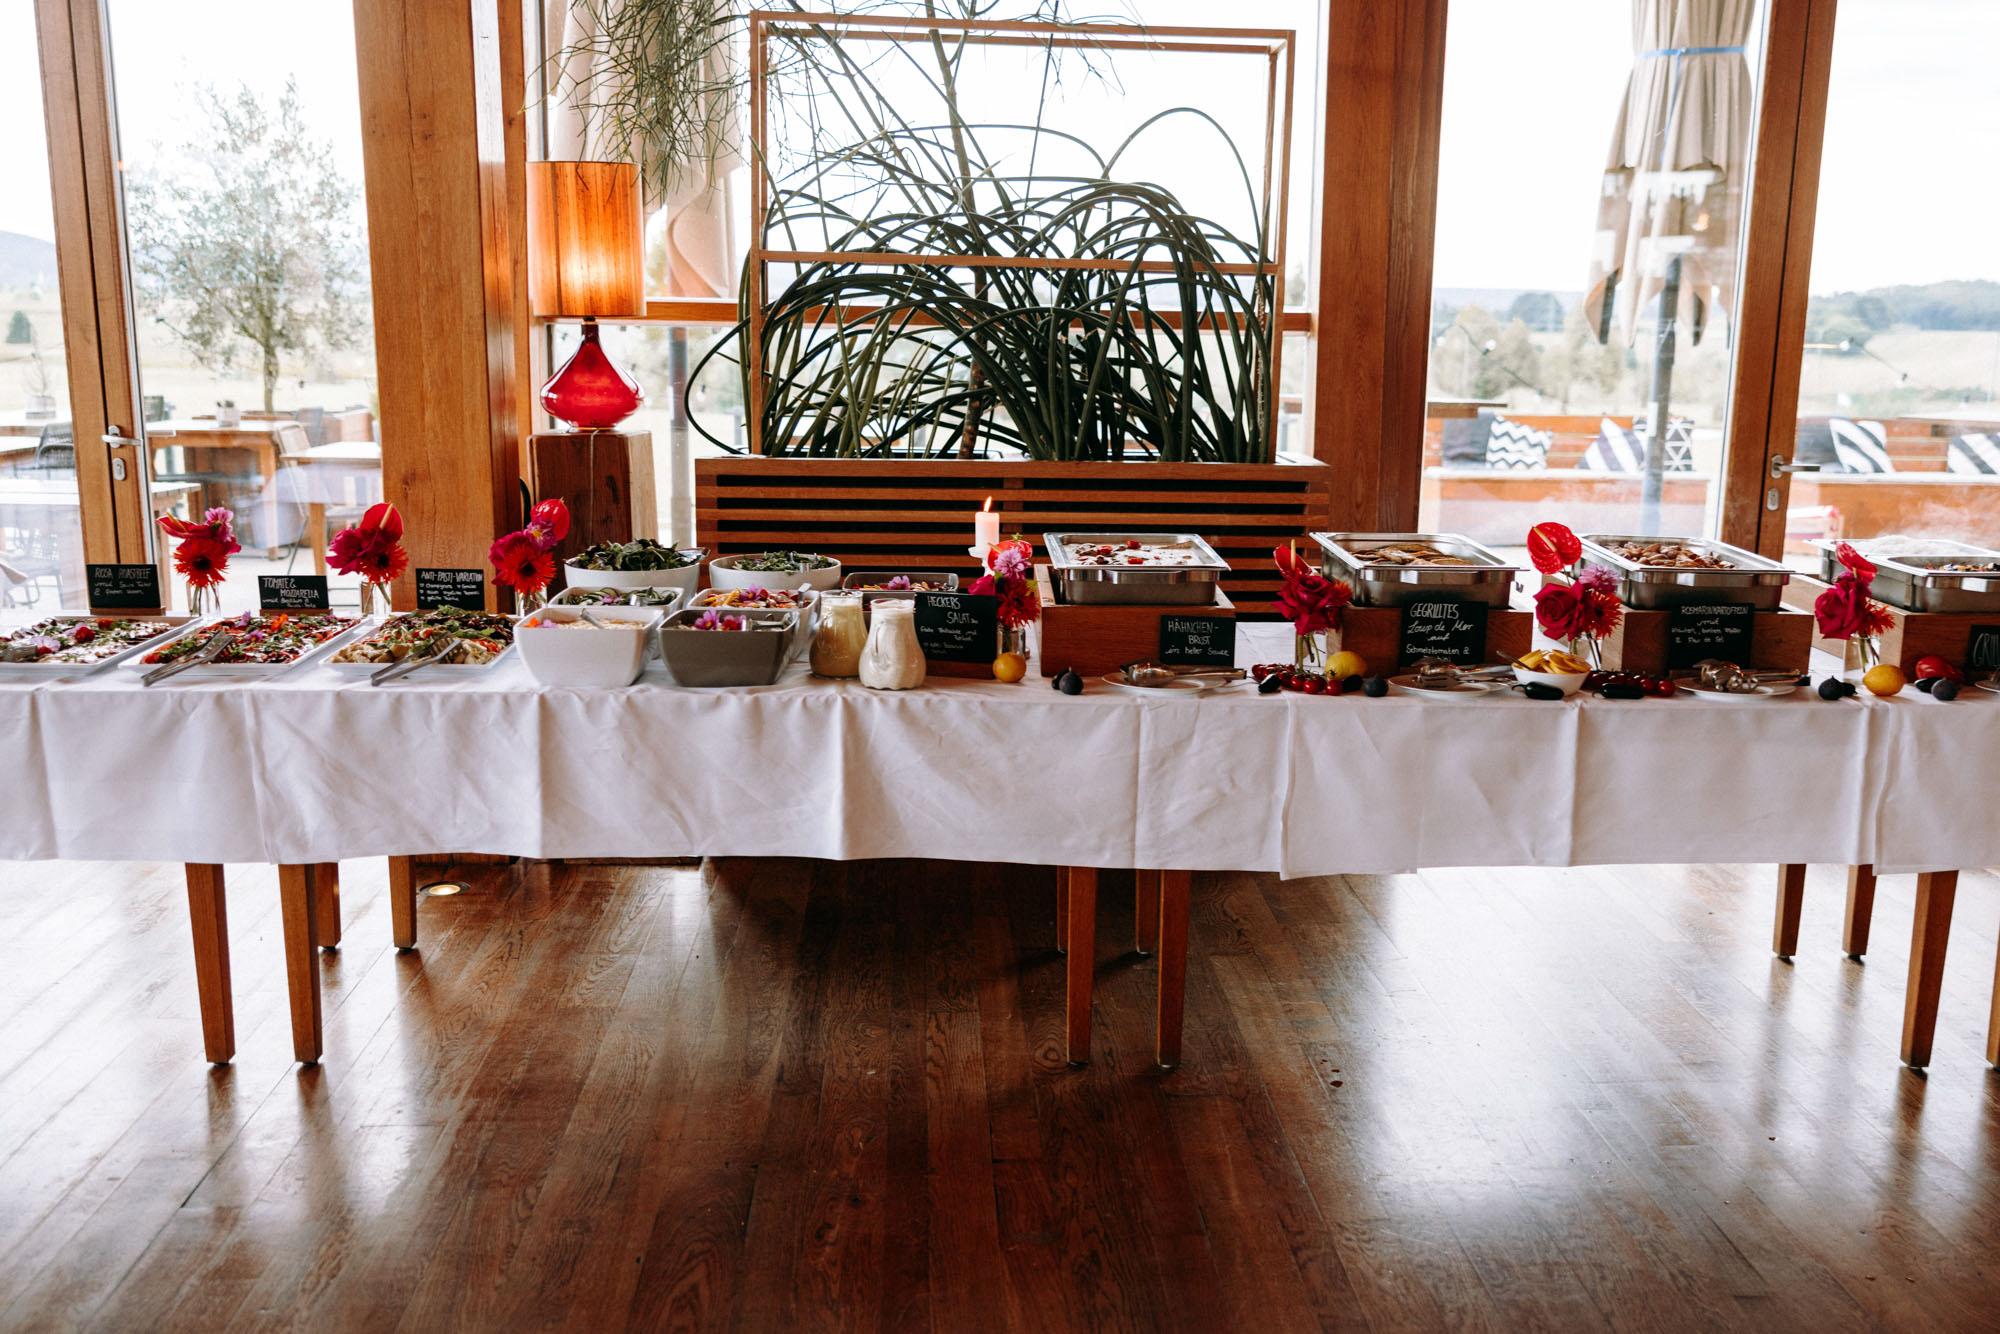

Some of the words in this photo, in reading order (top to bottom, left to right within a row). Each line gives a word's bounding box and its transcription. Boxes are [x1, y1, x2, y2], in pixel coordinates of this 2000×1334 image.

[95, 568, 113, 579] ROSA
[280, 589, 319, 598] MOZZARELLA
[927, 596, 960, 609] HECKERS
[1410, 603, 1459, 619] GEGRILLTES
[946, 611, 970, 624] SALAT
[1188, 634, 1211, 645] BRUST
